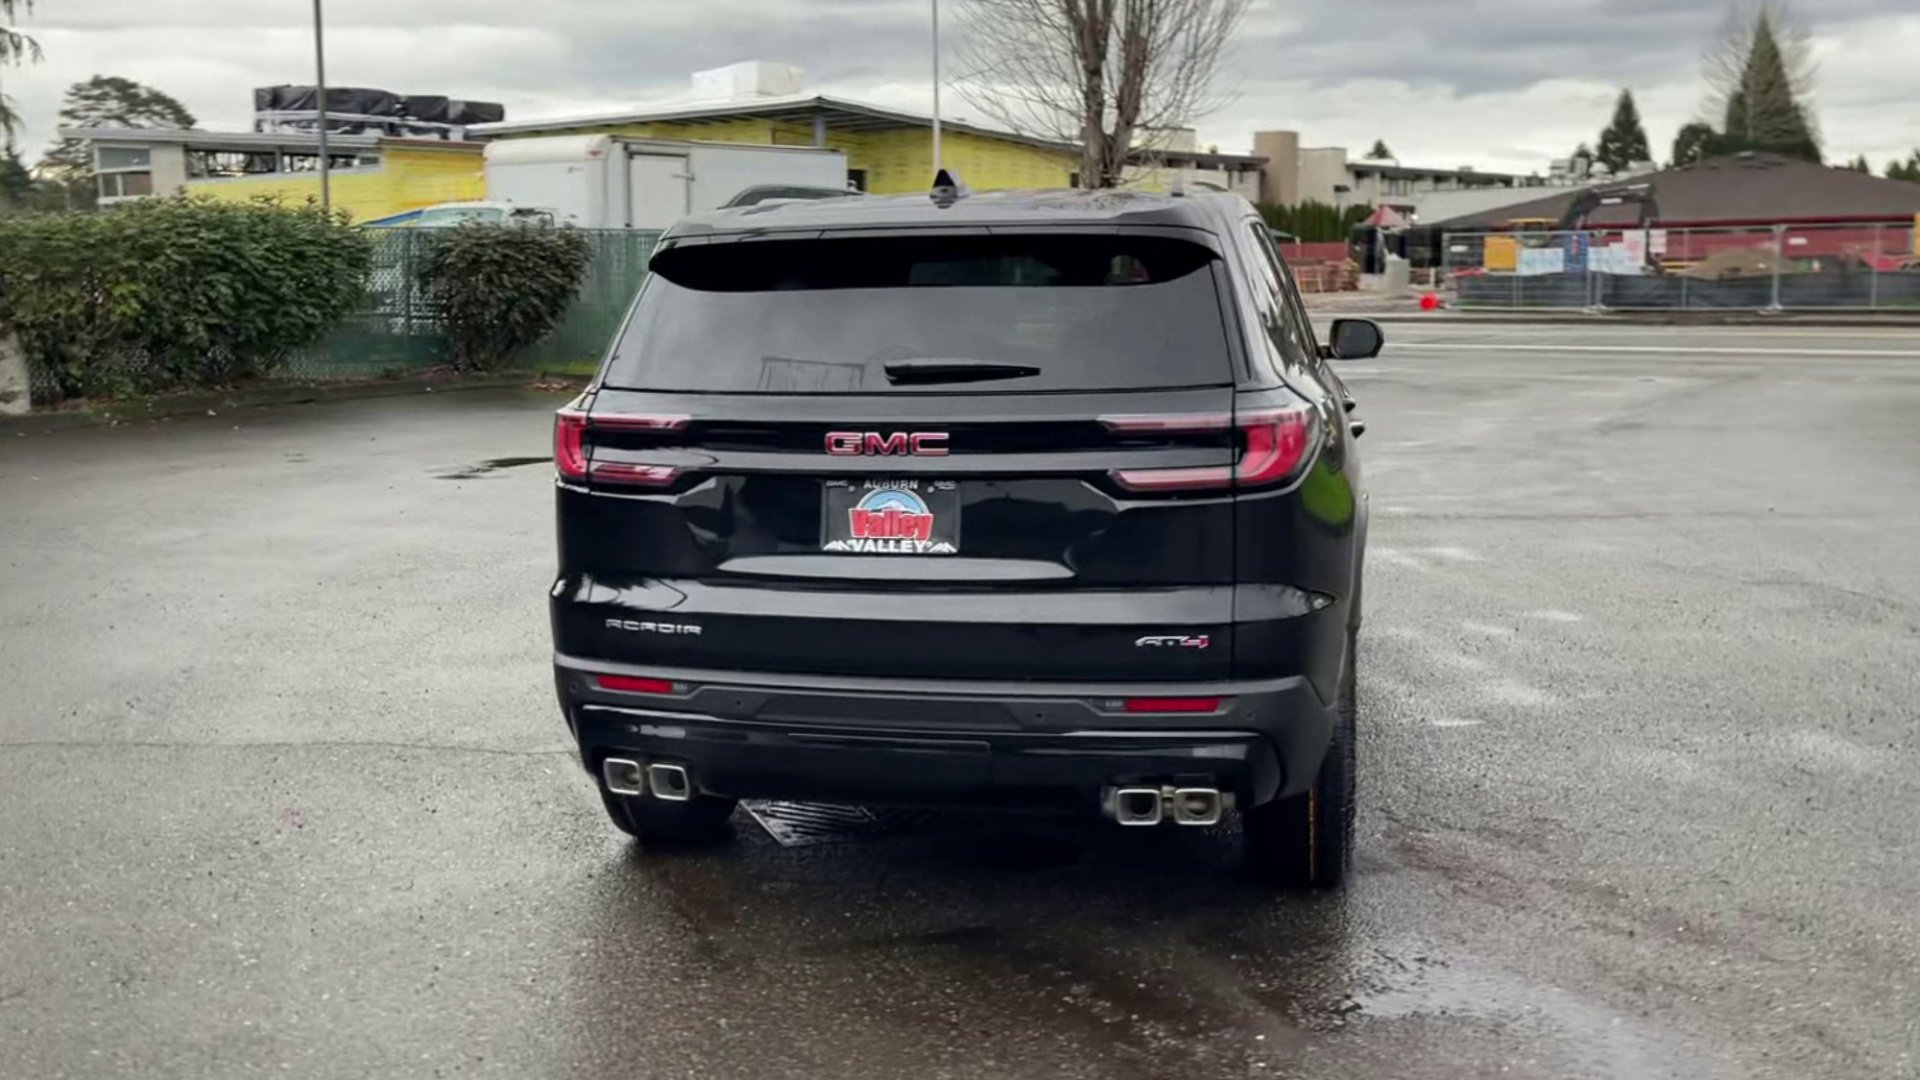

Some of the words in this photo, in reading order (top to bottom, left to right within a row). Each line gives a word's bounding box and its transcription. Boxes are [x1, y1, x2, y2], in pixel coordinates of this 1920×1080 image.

[825, 432, 949, 456] GMC
[863, 480, 918, 490] AUBURN
[849, 508, 933, 542] Valley
[850, 539, 925, 553] VALLEY
[605, 618, 703, 636] ACADIA
[1134, 635, 1209, 649] AT4
